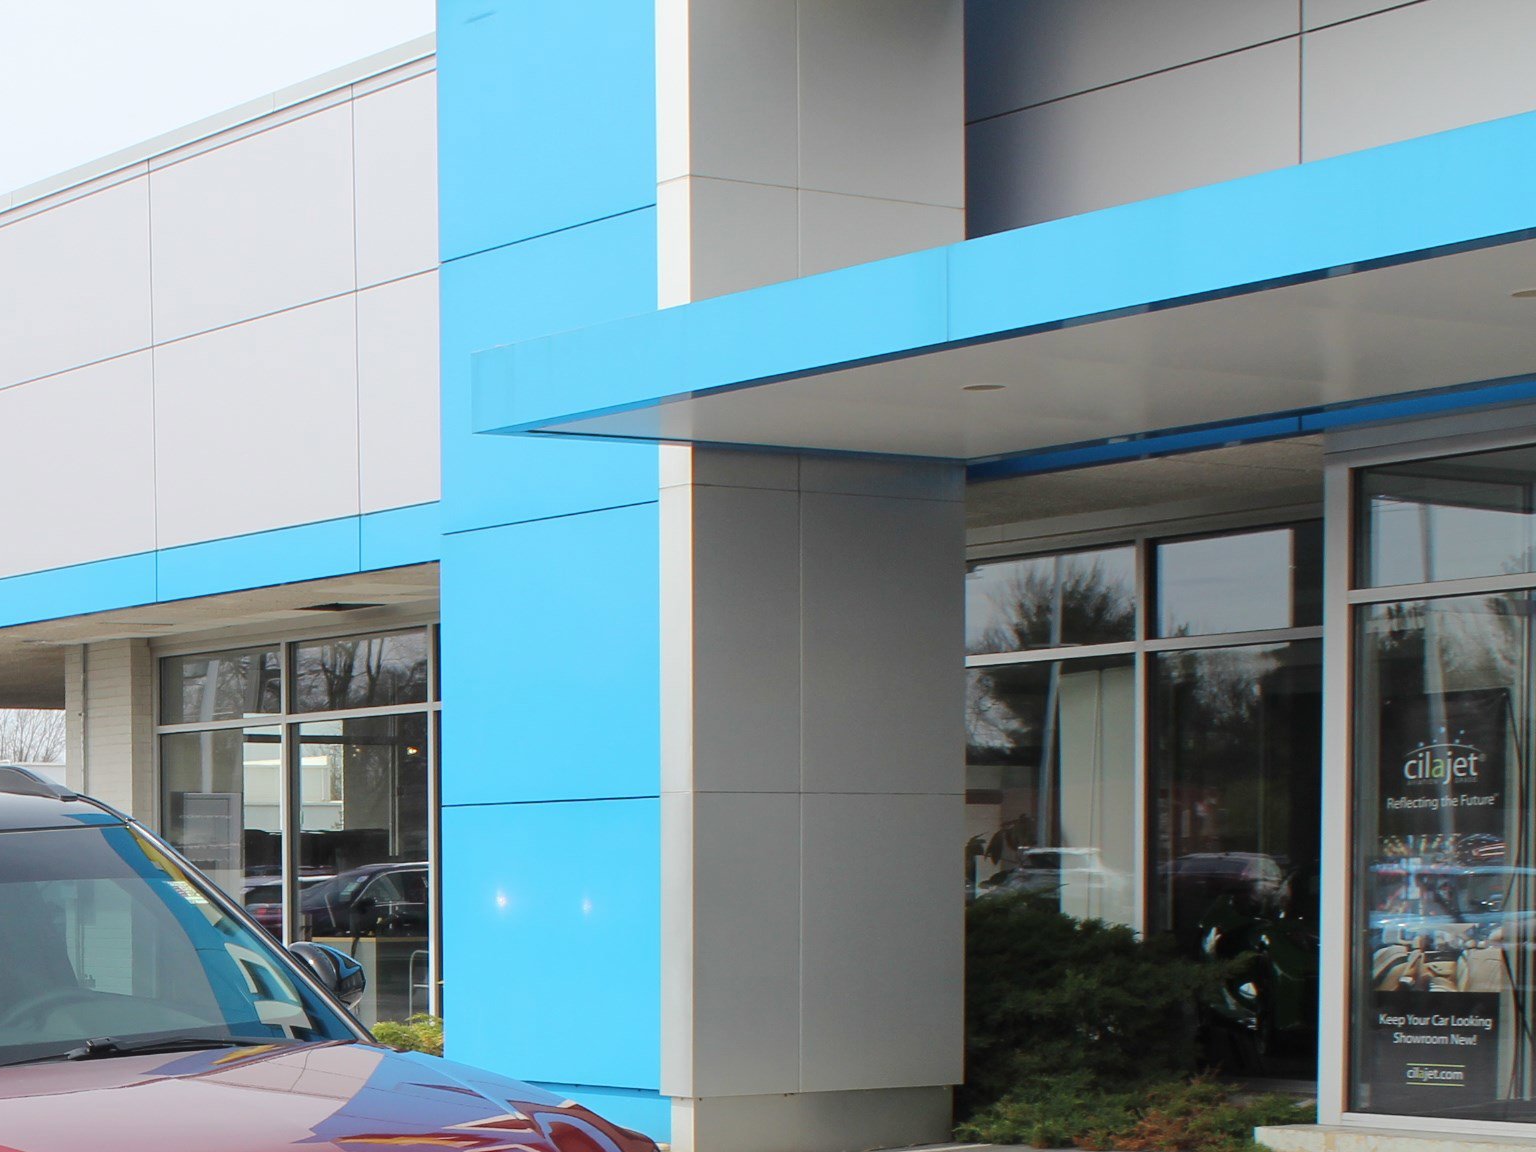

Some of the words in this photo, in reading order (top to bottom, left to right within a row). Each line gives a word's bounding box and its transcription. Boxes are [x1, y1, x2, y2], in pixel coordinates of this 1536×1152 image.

[1404, 751, 1479, 784] cilajet
[1387, 797, 1439, 810] Reflecting
[1441, 796, 1459, 807] the
[1379, 1013, 1405, 1027] Keep
[1406, 1014, 1430, 1026] Your
[1431, 1014, 1449, 1026] Car
[1451, 1015, 1492, 1030] Looking
[1392, 1031, 1449, 1045] Showroom
[1450, 1033, 1477, 1046] New!
[1406, 1066, 1464, 1082] cilajet.com
